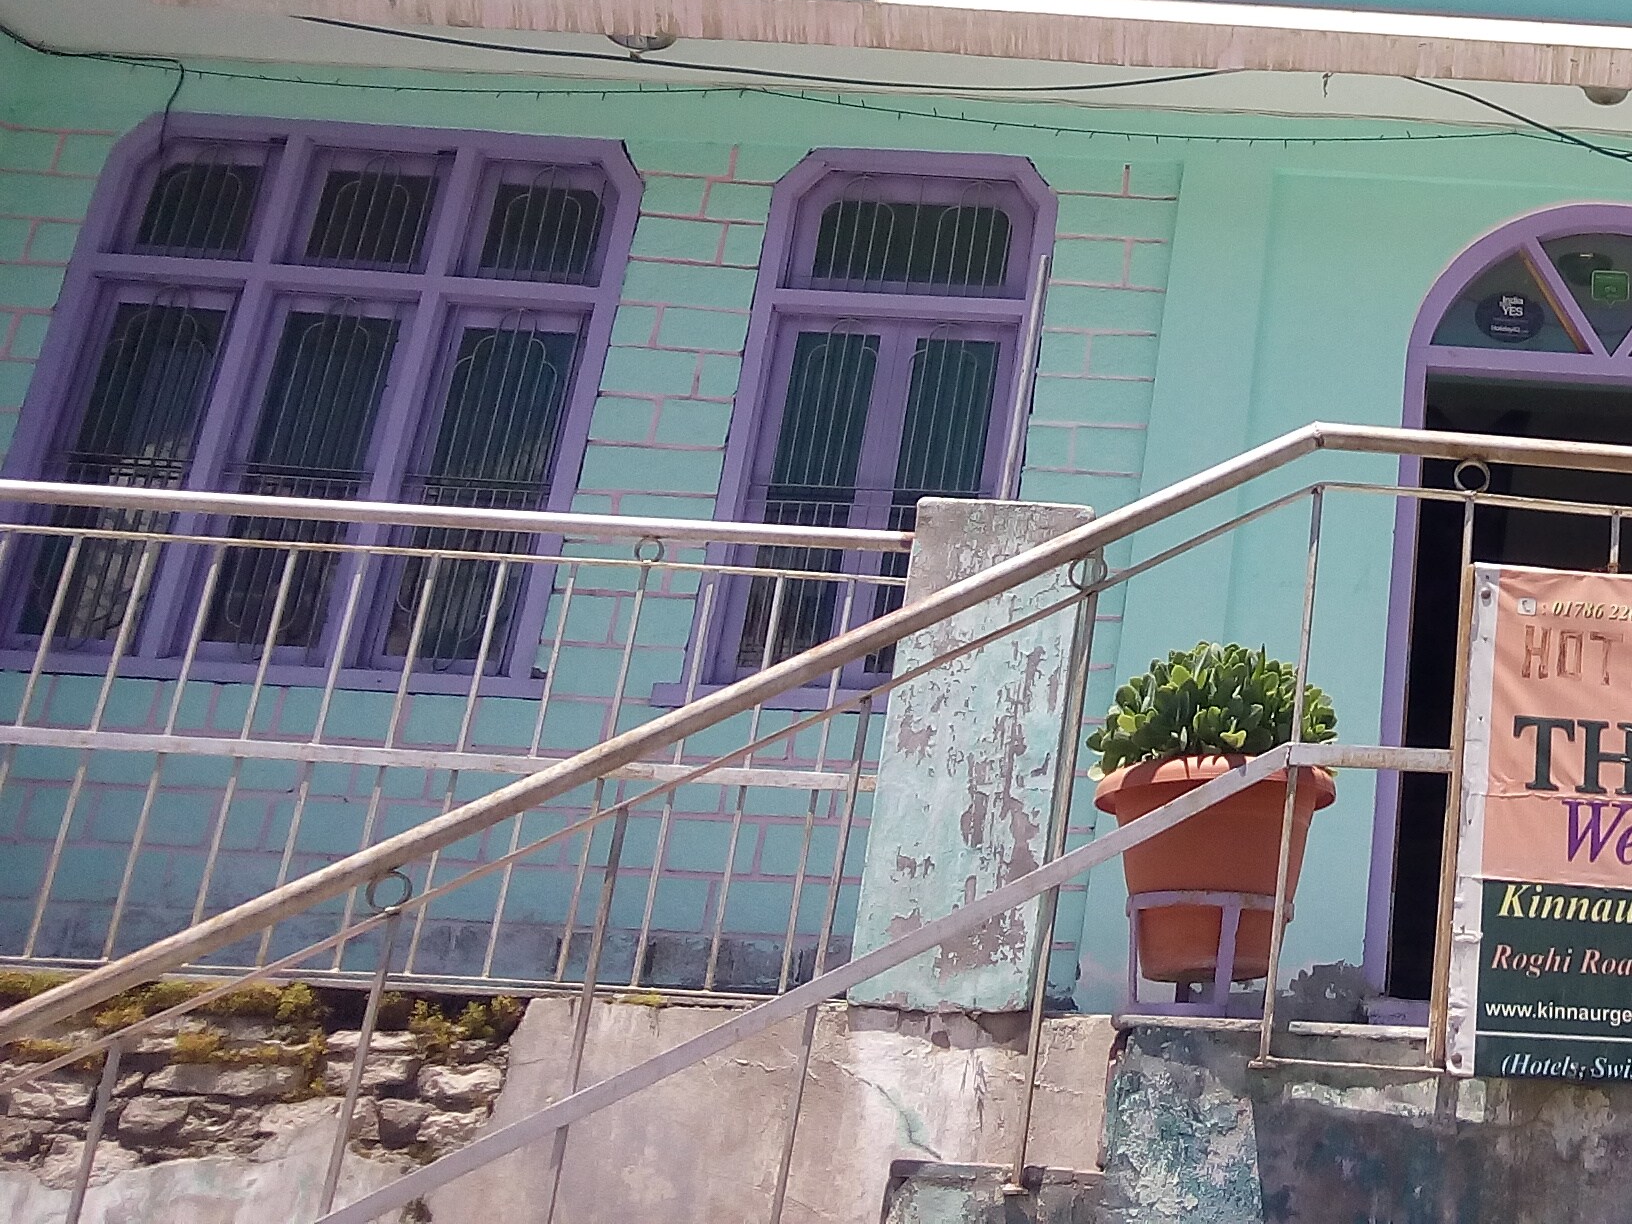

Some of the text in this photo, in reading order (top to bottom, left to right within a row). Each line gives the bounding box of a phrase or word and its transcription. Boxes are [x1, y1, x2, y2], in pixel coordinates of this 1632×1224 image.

[1502, 306, 1524, 317] YES
[1552, 601, 1604, 620] 01786
[1491, 944, 1573, 978] Roghi
